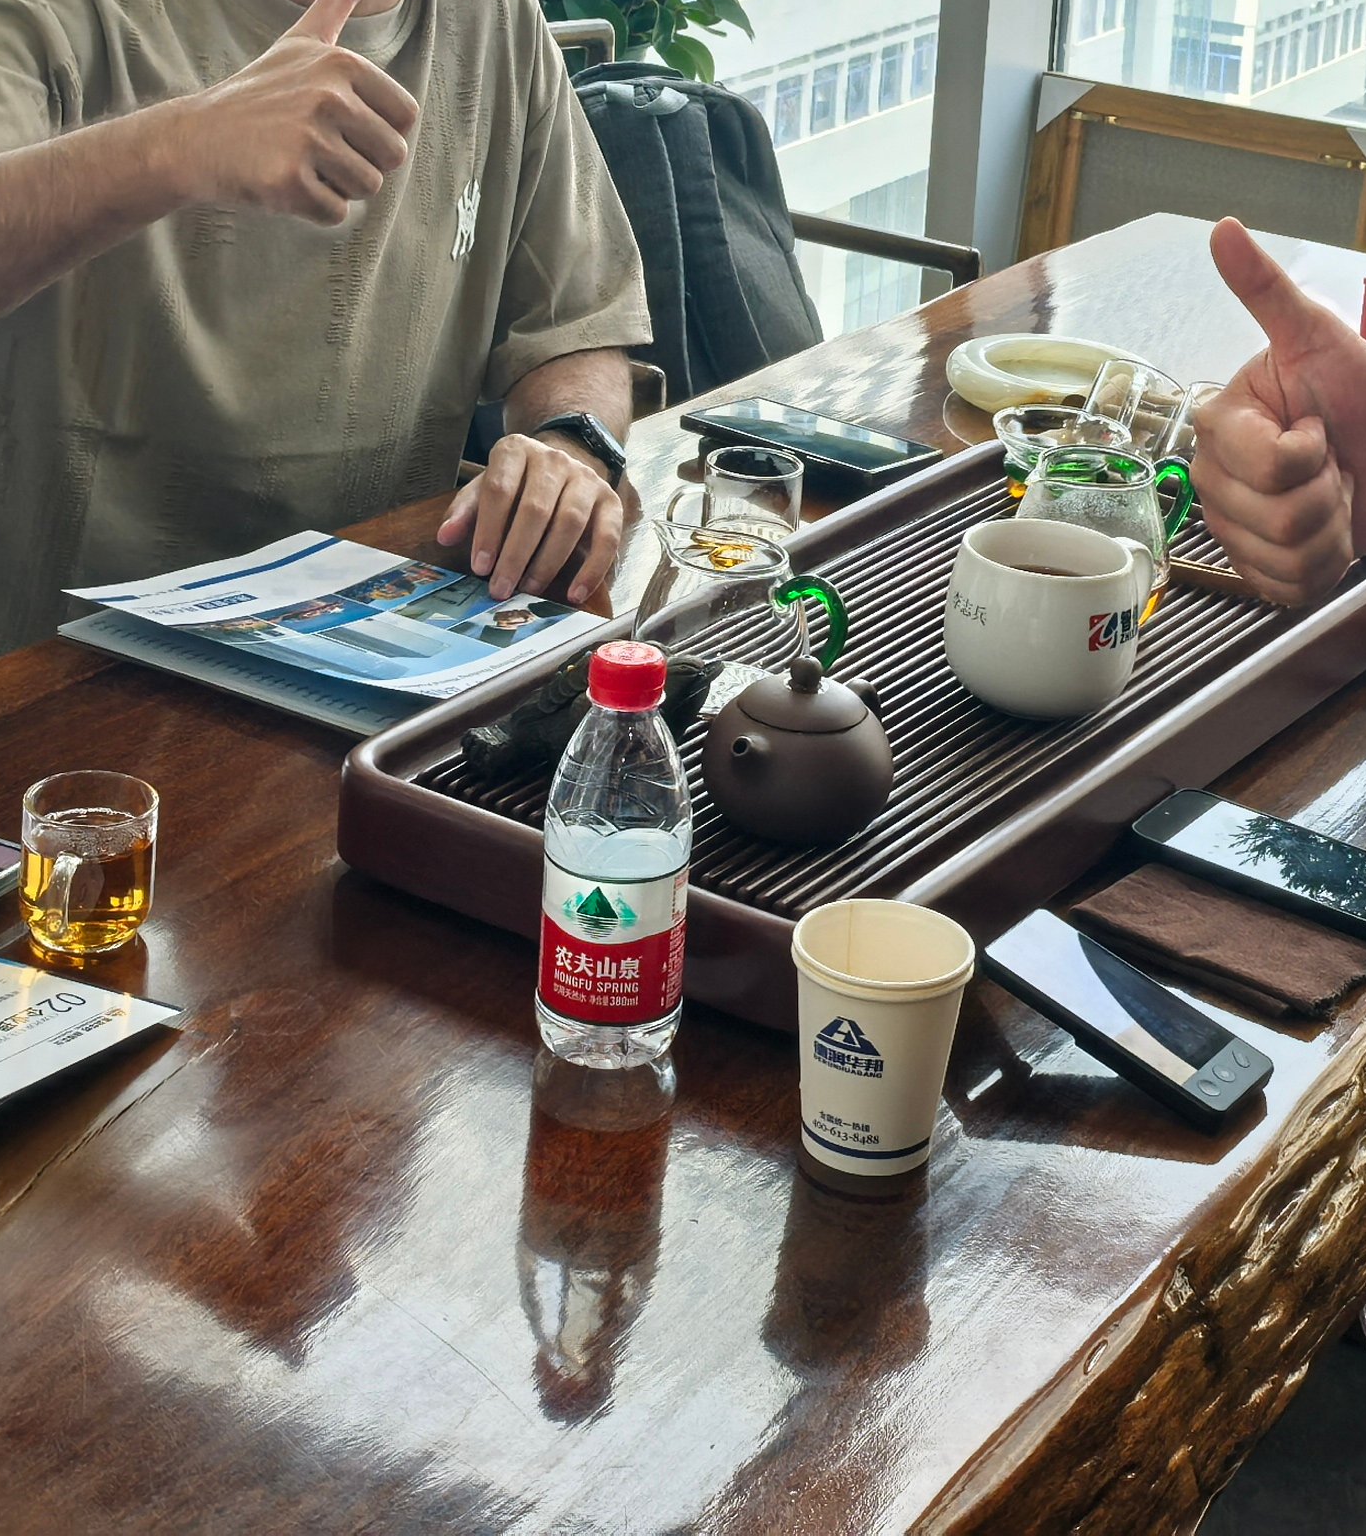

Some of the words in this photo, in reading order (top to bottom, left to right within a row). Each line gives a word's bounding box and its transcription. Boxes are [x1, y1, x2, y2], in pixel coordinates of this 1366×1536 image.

[555, 944, 640, 980] 农夫山泉
[554, 967, 592, 992] NONGFU
[596, 981, 639, 994] SPRING
[37, 992, 86, 1014] 02
[812, 1118, 880, 1145] 400-613-8488
